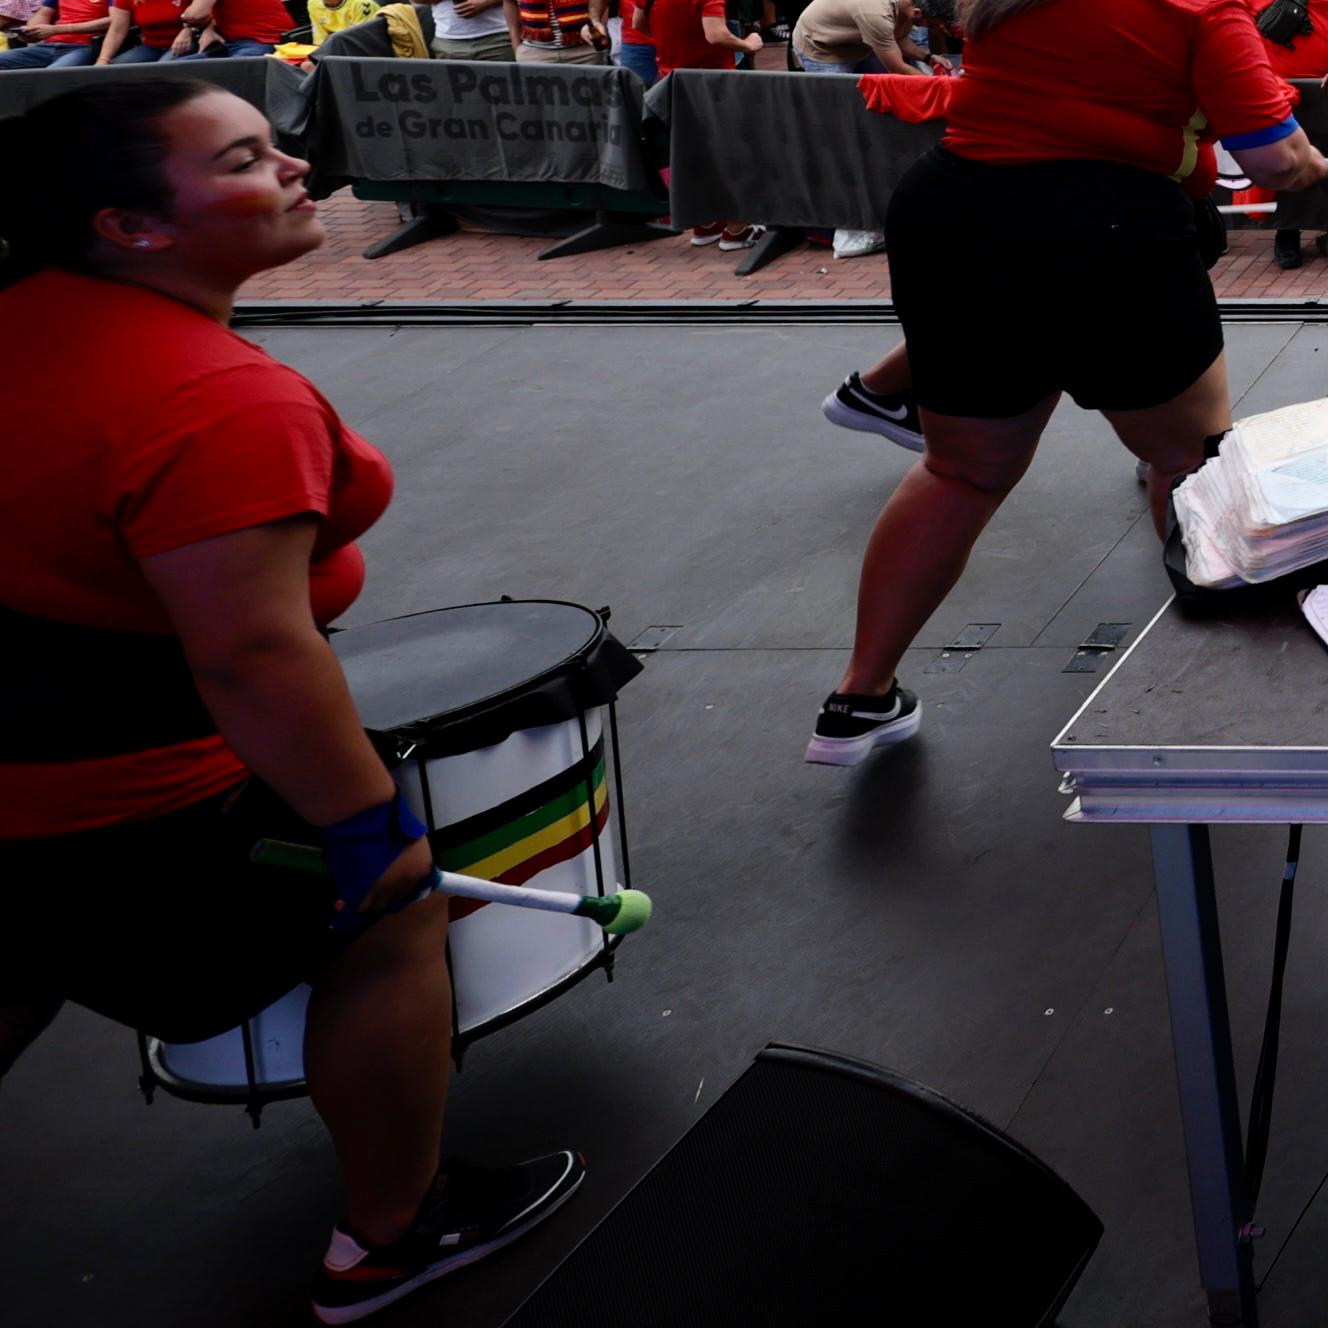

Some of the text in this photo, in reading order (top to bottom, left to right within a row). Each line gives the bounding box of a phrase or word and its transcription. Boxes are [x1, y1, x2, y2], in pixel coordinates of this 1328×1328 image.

[350, 62, 623, 107] Las Palmas
[355, 110, 621, 145] de Gran Canaria
